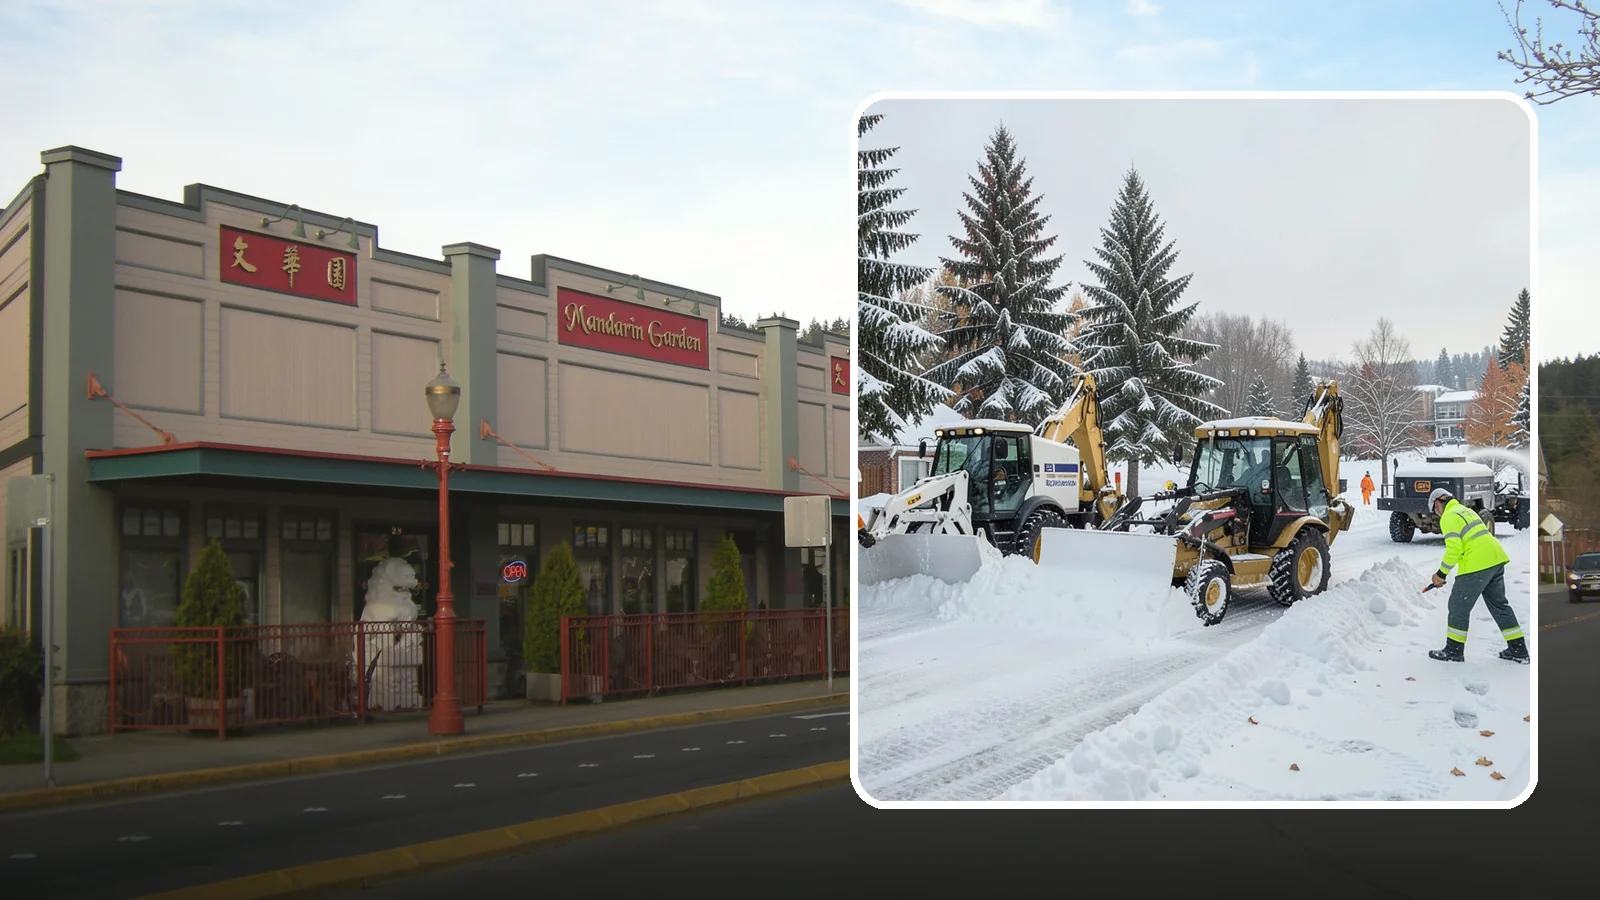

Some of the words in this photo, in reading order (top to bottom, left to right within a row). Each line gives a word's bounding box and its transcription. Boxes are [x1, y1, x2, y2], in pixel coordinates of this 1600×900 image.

[231, 235, 346, 290] 文華園
[564, 302, 643, 341] Mandarin
[648, 320, 701, 352] Garden
[503, 565, 527, 578] OPEN
